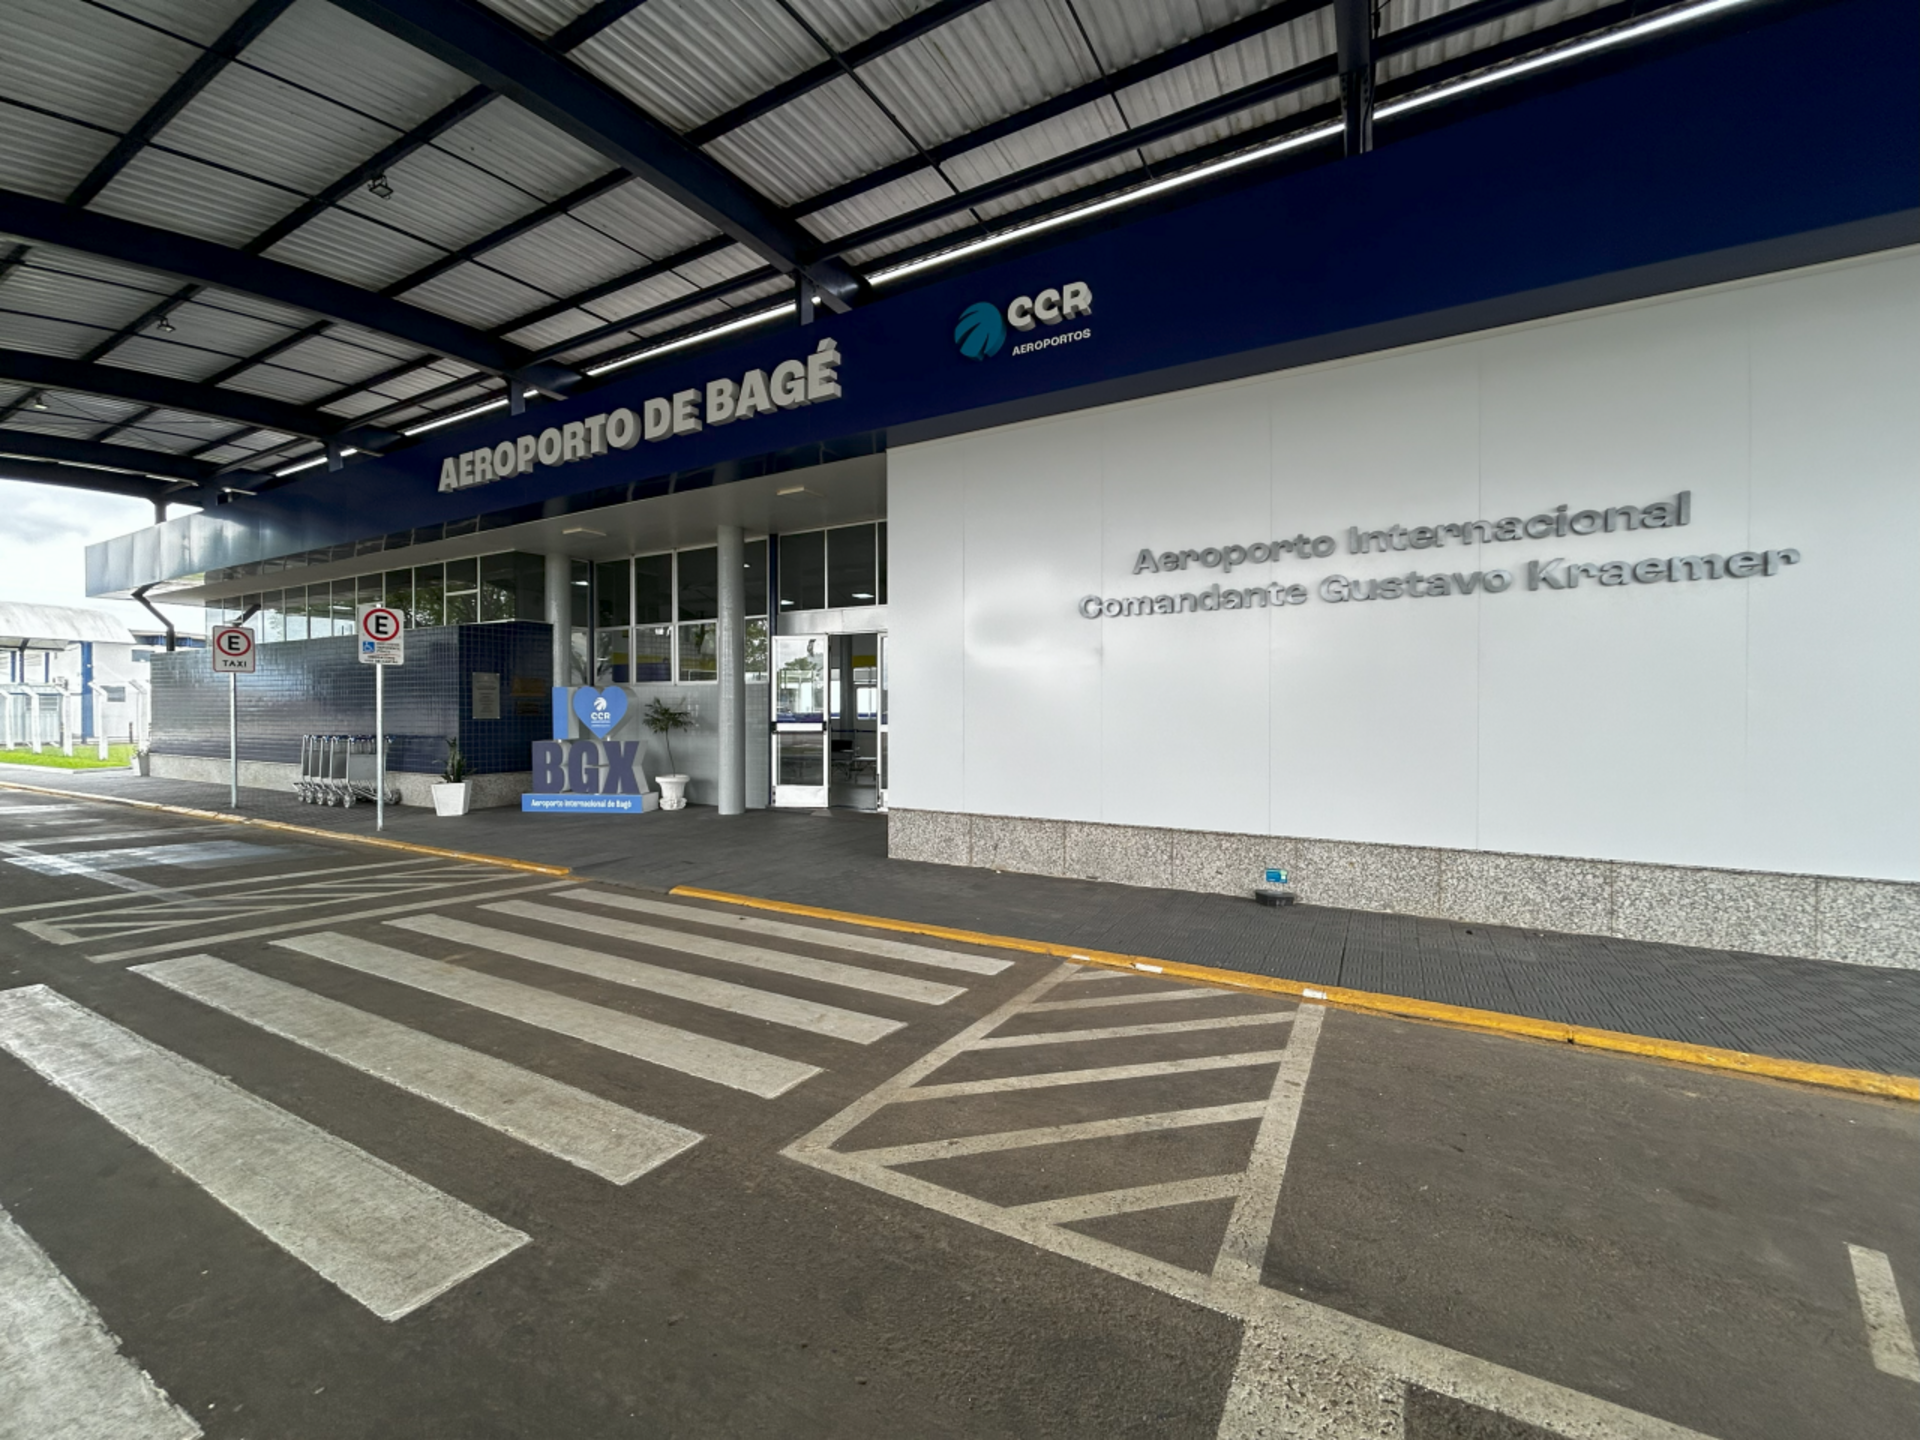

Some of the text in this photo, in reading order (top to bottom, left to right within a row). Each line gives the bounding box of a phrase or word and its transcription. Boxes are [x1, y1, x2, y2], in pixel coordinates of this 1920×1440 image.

[1007, 281, 1093, 332] CCR
[1012, 328, 1092, 356] AEROPORTOS
[438, 337, 842, 493] AEROPORTO DE BAGÉ
[1132, 490, 1691, 574] Aeroporto Internacional
[1078, 547, 1801, 621] Comandante Gustavo Kraemer
[375, 614, 389, 635] E
[227, 635, 241, 651] E
[222, 659, 247, 668] TAXI
[590, 711, 611, 721] CCR
[532, 740, 644, 794] BGX
[531, 798, 632, 810] Aeroporto Internacional de Bagé
